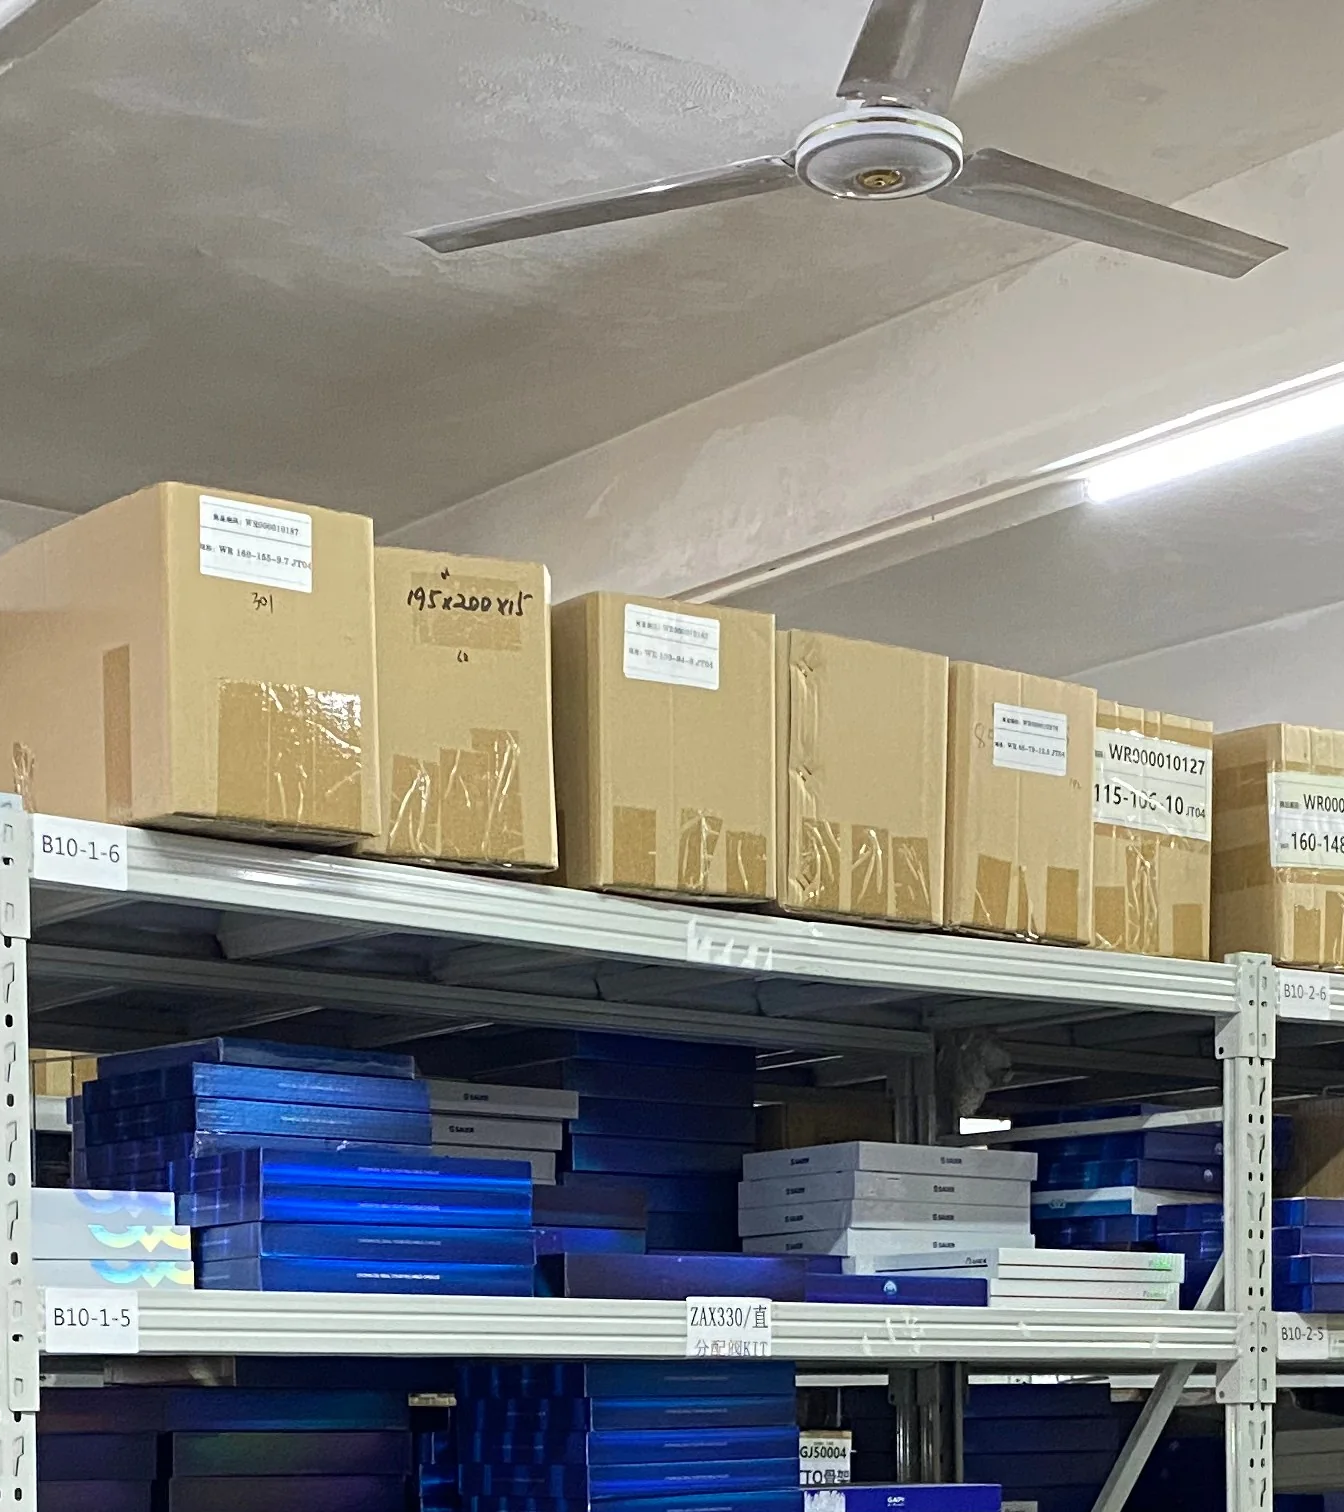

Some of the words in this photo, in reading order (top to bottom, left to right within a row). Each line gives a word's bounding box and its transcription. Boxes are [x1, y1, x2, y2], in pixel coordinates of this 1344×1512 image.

[40, 833, 121, 865] B10-1-6
[1284, 983, 1327, 1001] B10-2-6
[52, 1307, 131, 1328] B10-1-5
[690, 1305, 769, 1329] ZAX330/直
[1281, 1326, 1324, 1341] B10-2-5
[800, 1446, 846, 1460] GJ50004
